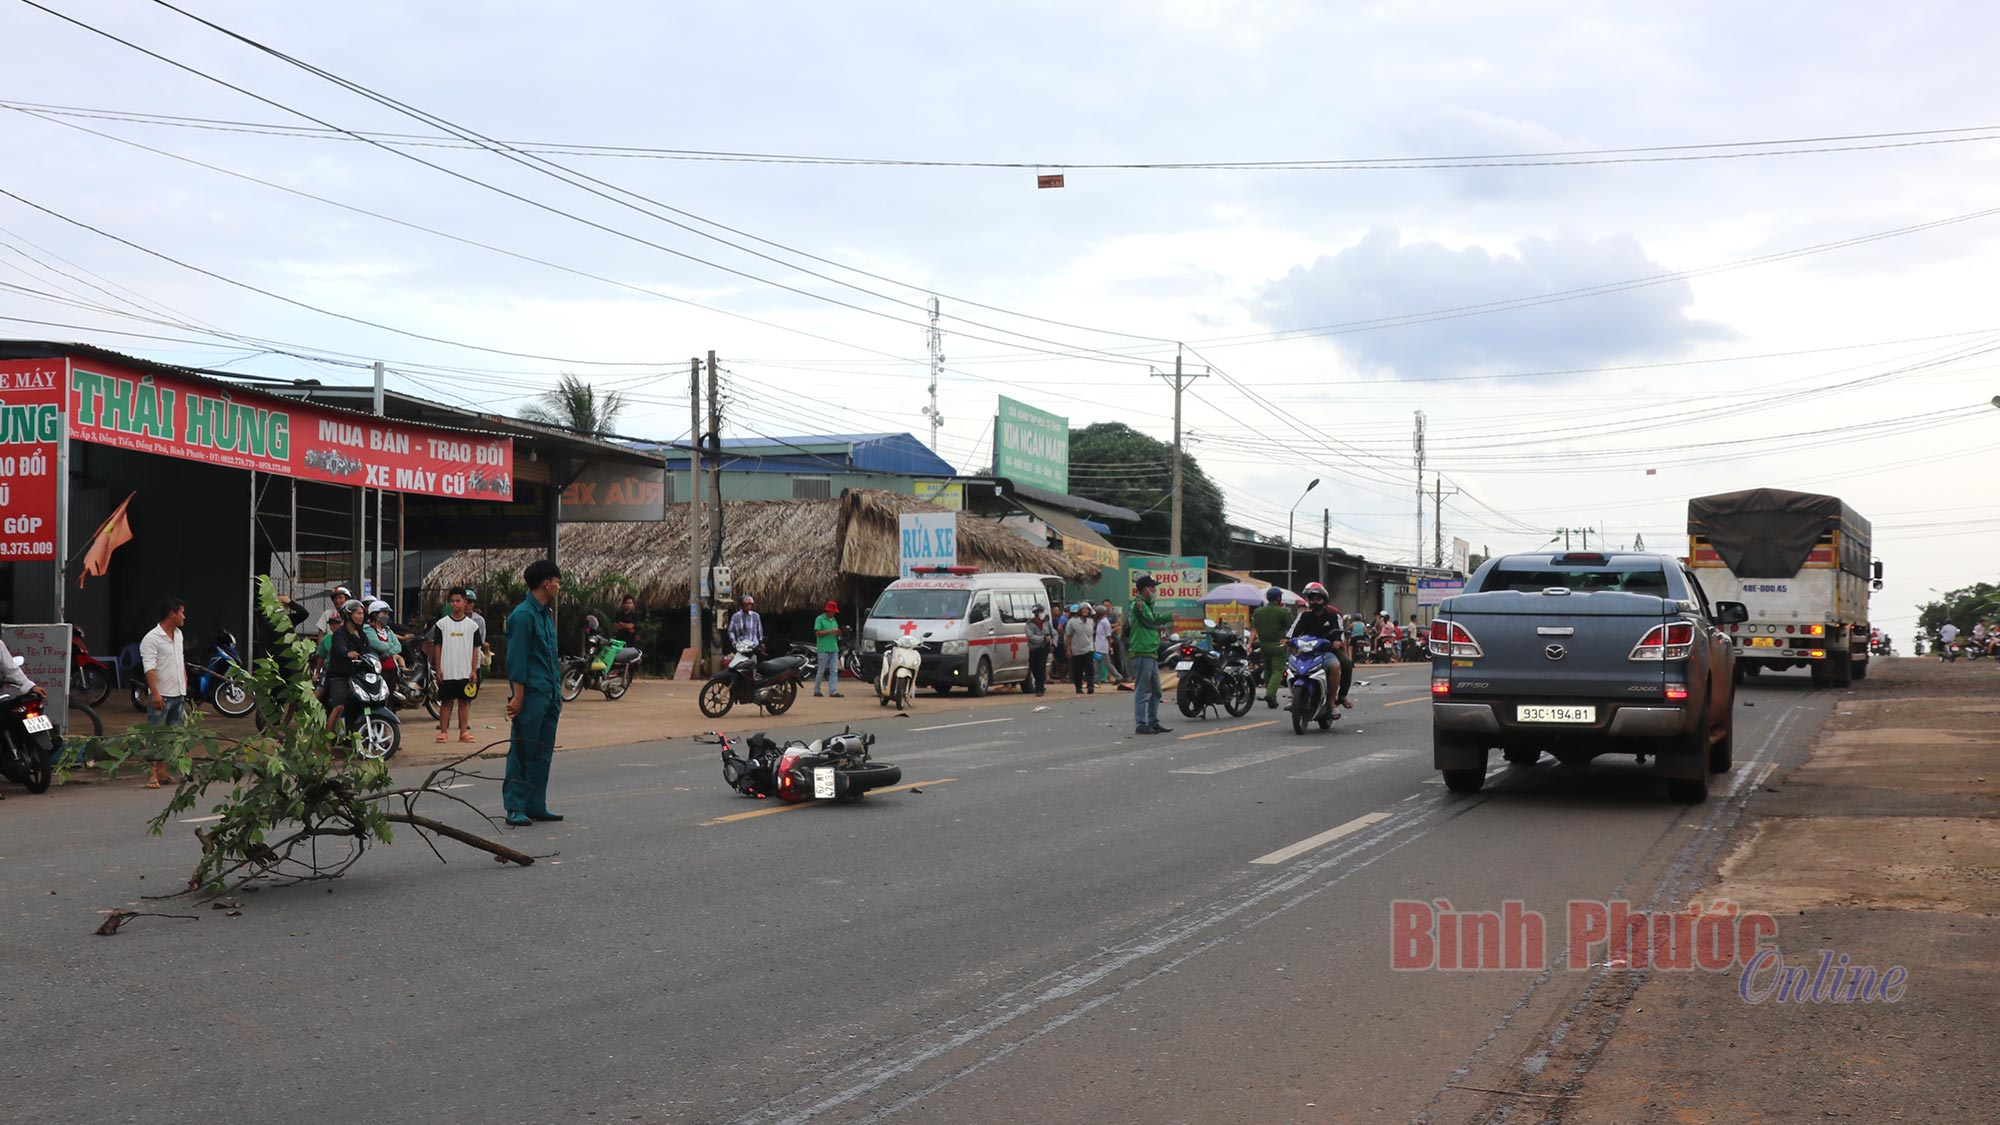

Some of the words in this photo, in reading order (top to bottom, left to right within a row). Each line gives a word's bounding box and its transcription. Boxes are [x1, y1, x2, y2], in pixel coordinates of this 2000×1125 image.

[14, 367, 57, 388] MÁY
[71, 368, 175, 441] THÁI
[185, 390, 289, 462] HÙNG
[318, 419, 364, 448] MUA
[370, 428, 410, 455] BÁN
[427, 438, 471, 463] TRAO
[476, 440, 504, 466] ĐỔI
[1003, 421, 1020, 451] KIM
[1045, 436, 1067, 465] MART
[19, 448, 46, 476] ĐỔI
[365, 463, 390, 487] XE
[396, 467, 436, 493] MÁY
[442, 471, 465, 495] CŨ
[4, 514, 43, 534] GÓP
[903, 516, 932, 558] RỬA
[935, 528, 953, 557] XE
[891, 581, 969, 590] AMBULANCE
[1155, 570, 1179, 583] PHỞ
[1160, 586, 1175, 597] BÒ
[1178, 585, 1203, 597] HUẾ
[1523, 708, 1589, 720] 93C-194.81
